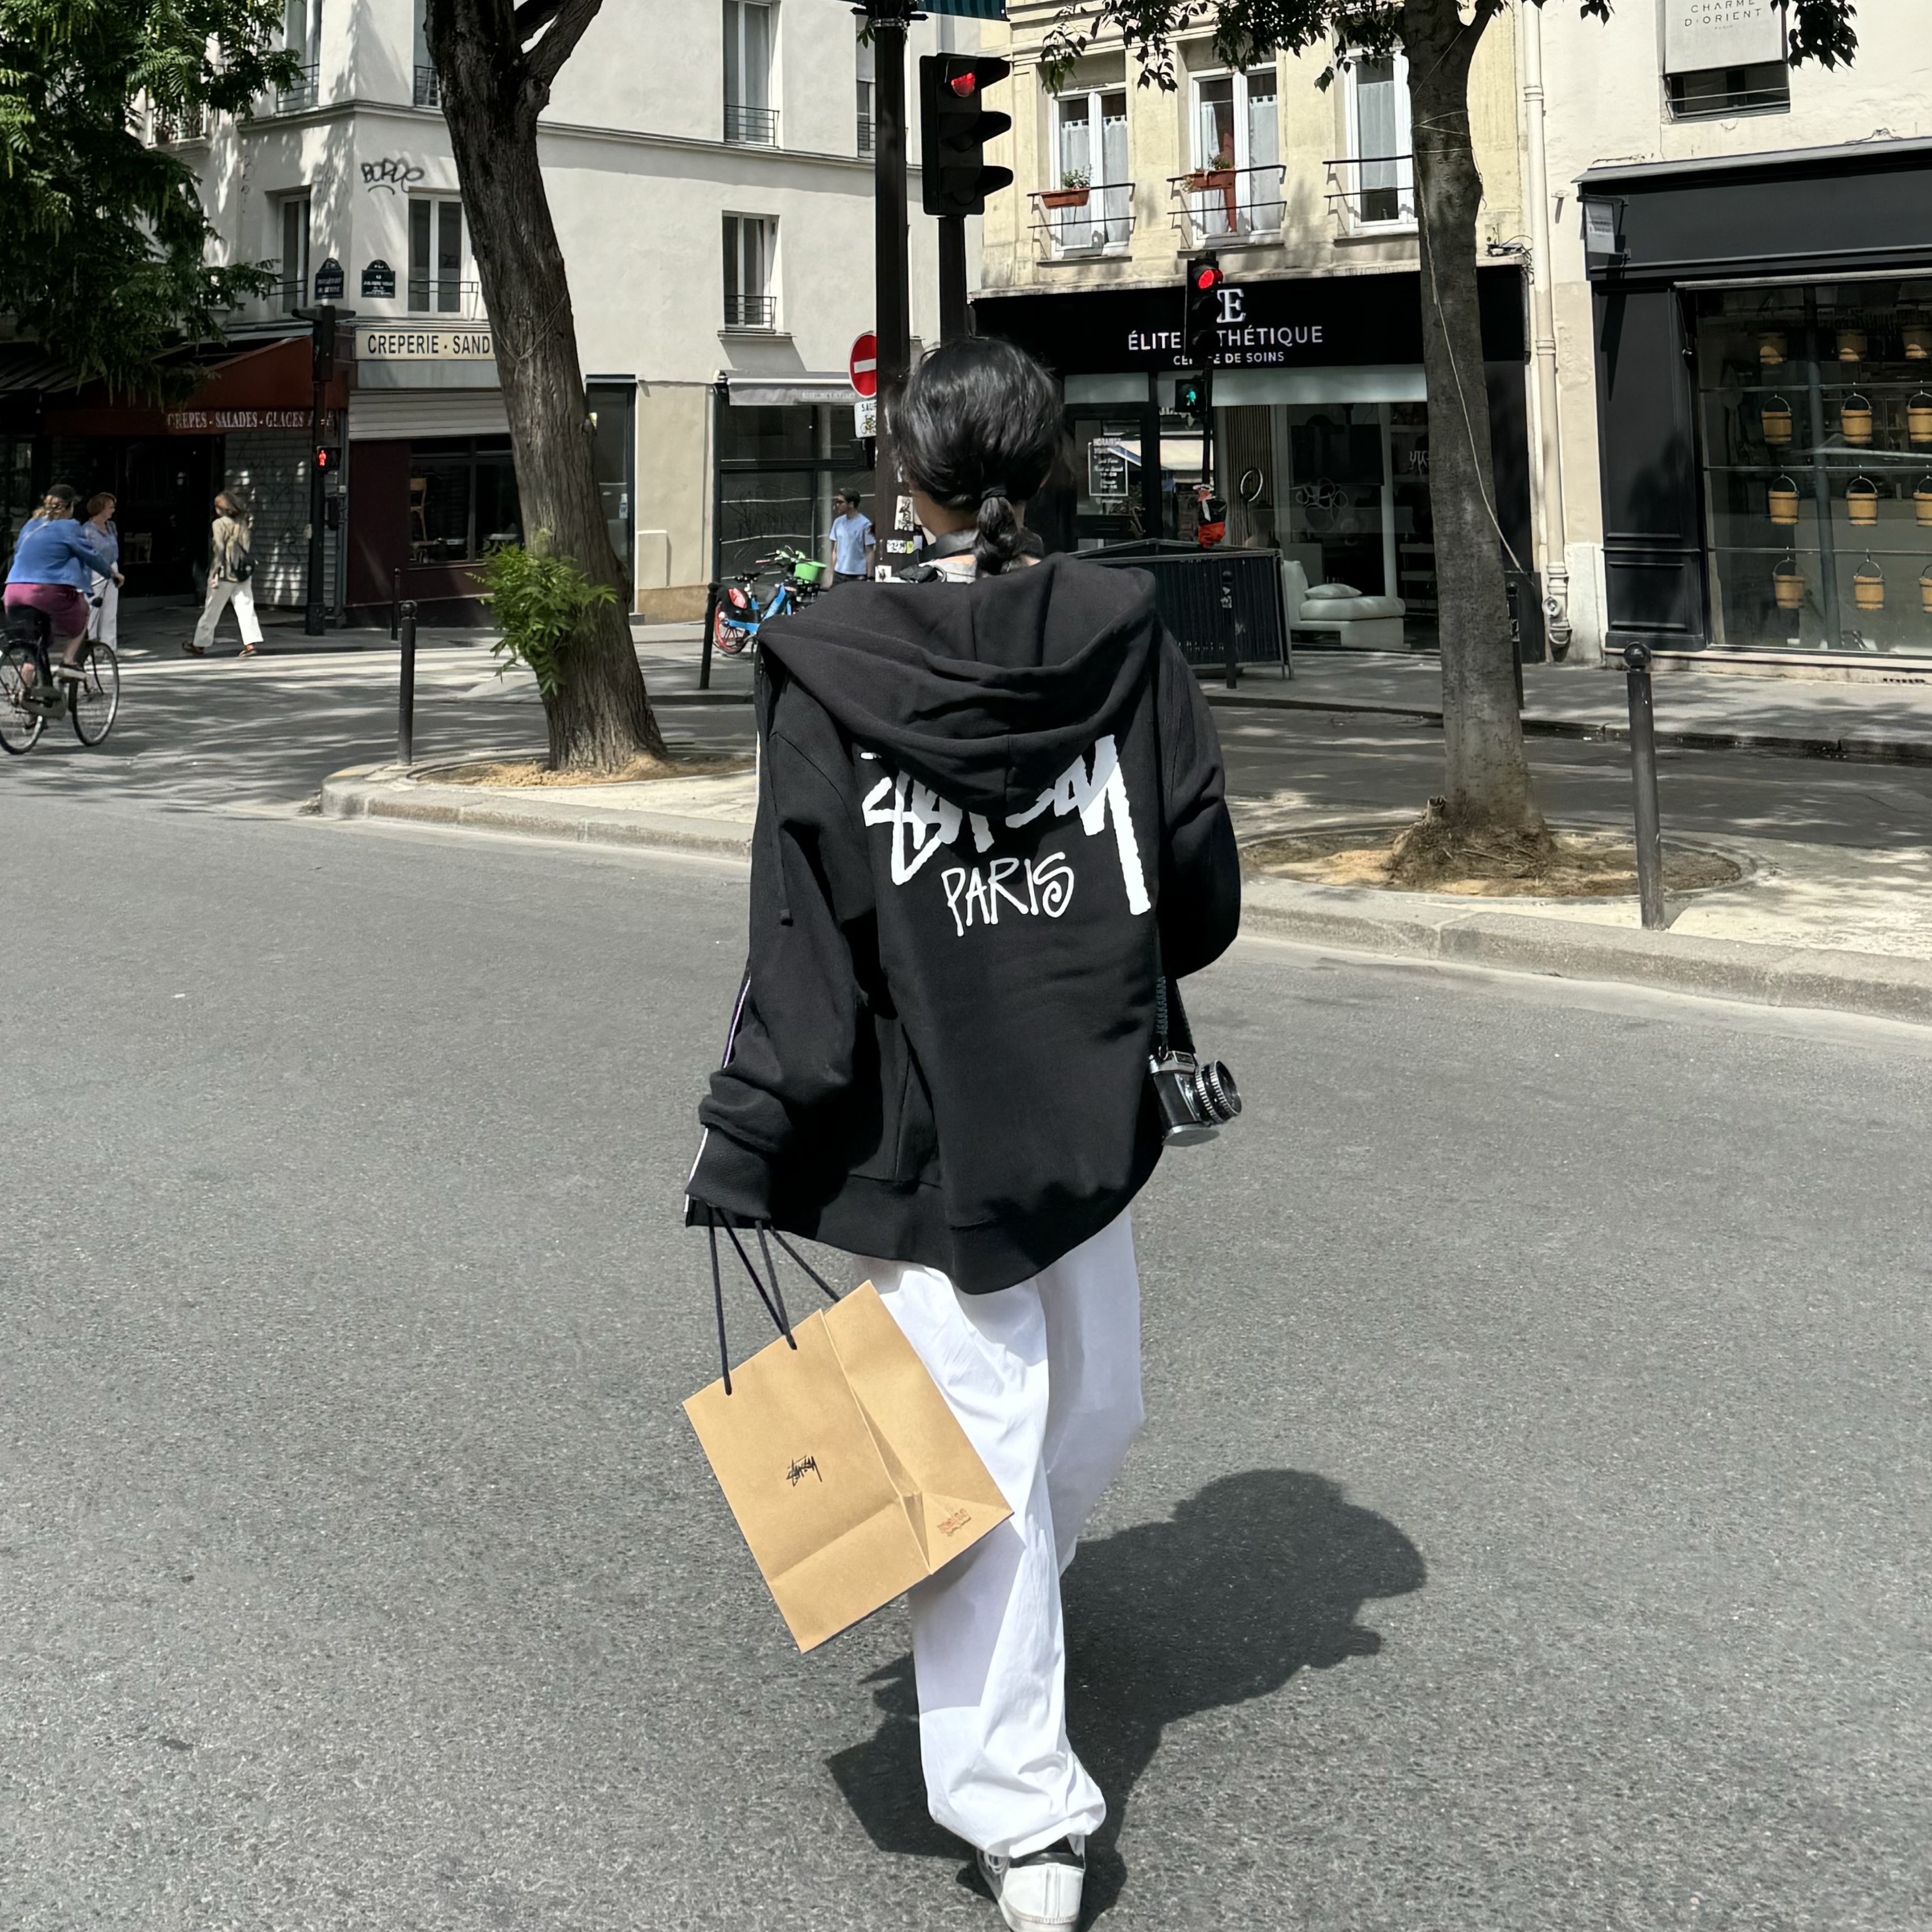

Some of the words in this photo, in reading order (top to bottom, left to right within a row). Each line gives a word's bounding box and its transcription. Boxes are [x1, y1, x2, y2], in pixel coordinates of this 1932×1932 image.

[1691, 0, 1755, 13] CHARME
[1684, 8, 1762, 26] D'ORIENT
[368, 334, 439, 354] CREPERIE
[453, 335, 490, 354] SAND
[1128, 330, 1181, 350] ÉLITE
[1225, 353, 1241, 363] DE
[1246, 352, 1284, 363] SOINS
[215, 411, 257, 427] SALADES
[266, 410, 303, 427] GLACES
[941, 852, 1075, 937] PARIS
